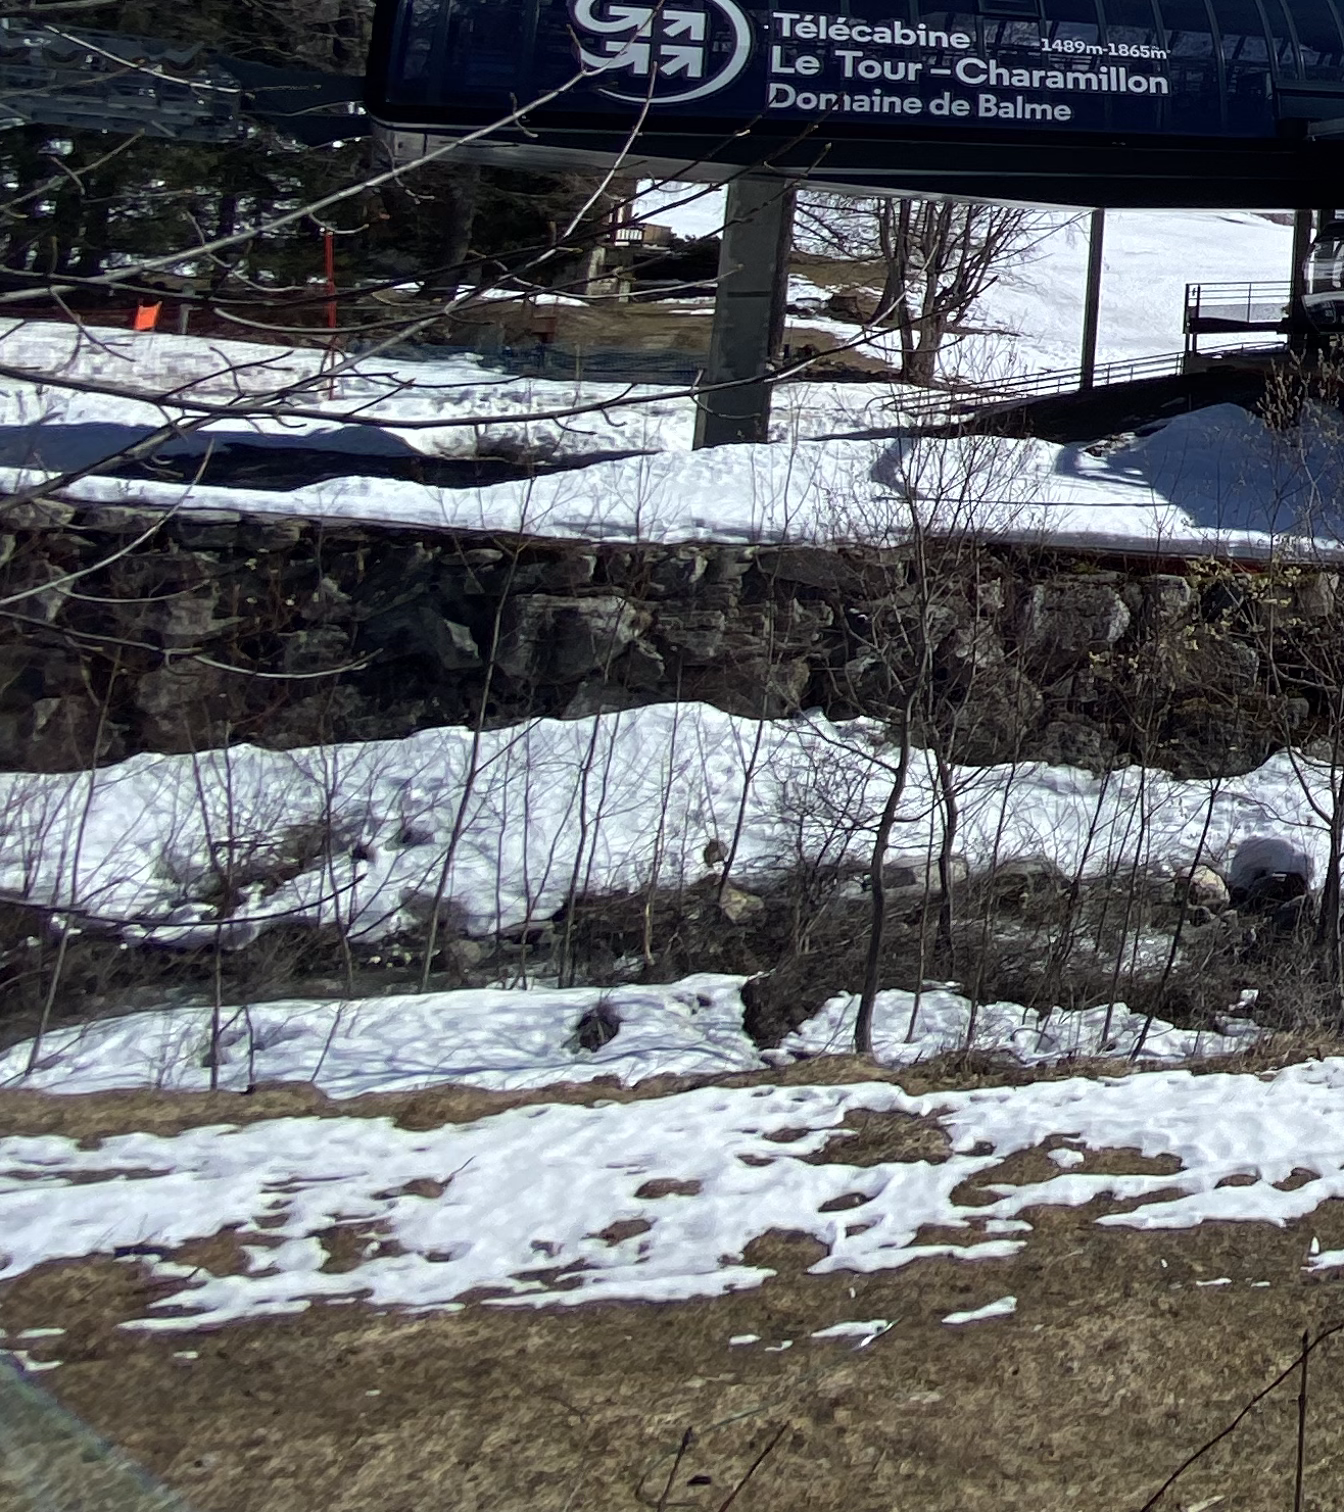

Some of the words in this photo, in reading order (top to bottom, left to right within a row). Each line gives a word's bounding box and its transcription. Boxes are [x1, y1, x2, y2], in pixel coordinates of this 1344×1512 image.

[773, 12, 971, 49] Télécabine
[771, 45, 820, 75] Le
[1041, 38, 1168, 60] 1489m-1865m
[769, 83, 923, 114] Domaine
[929, 92, 971, 117] de
[978, 94, 1072, 121] Balme
